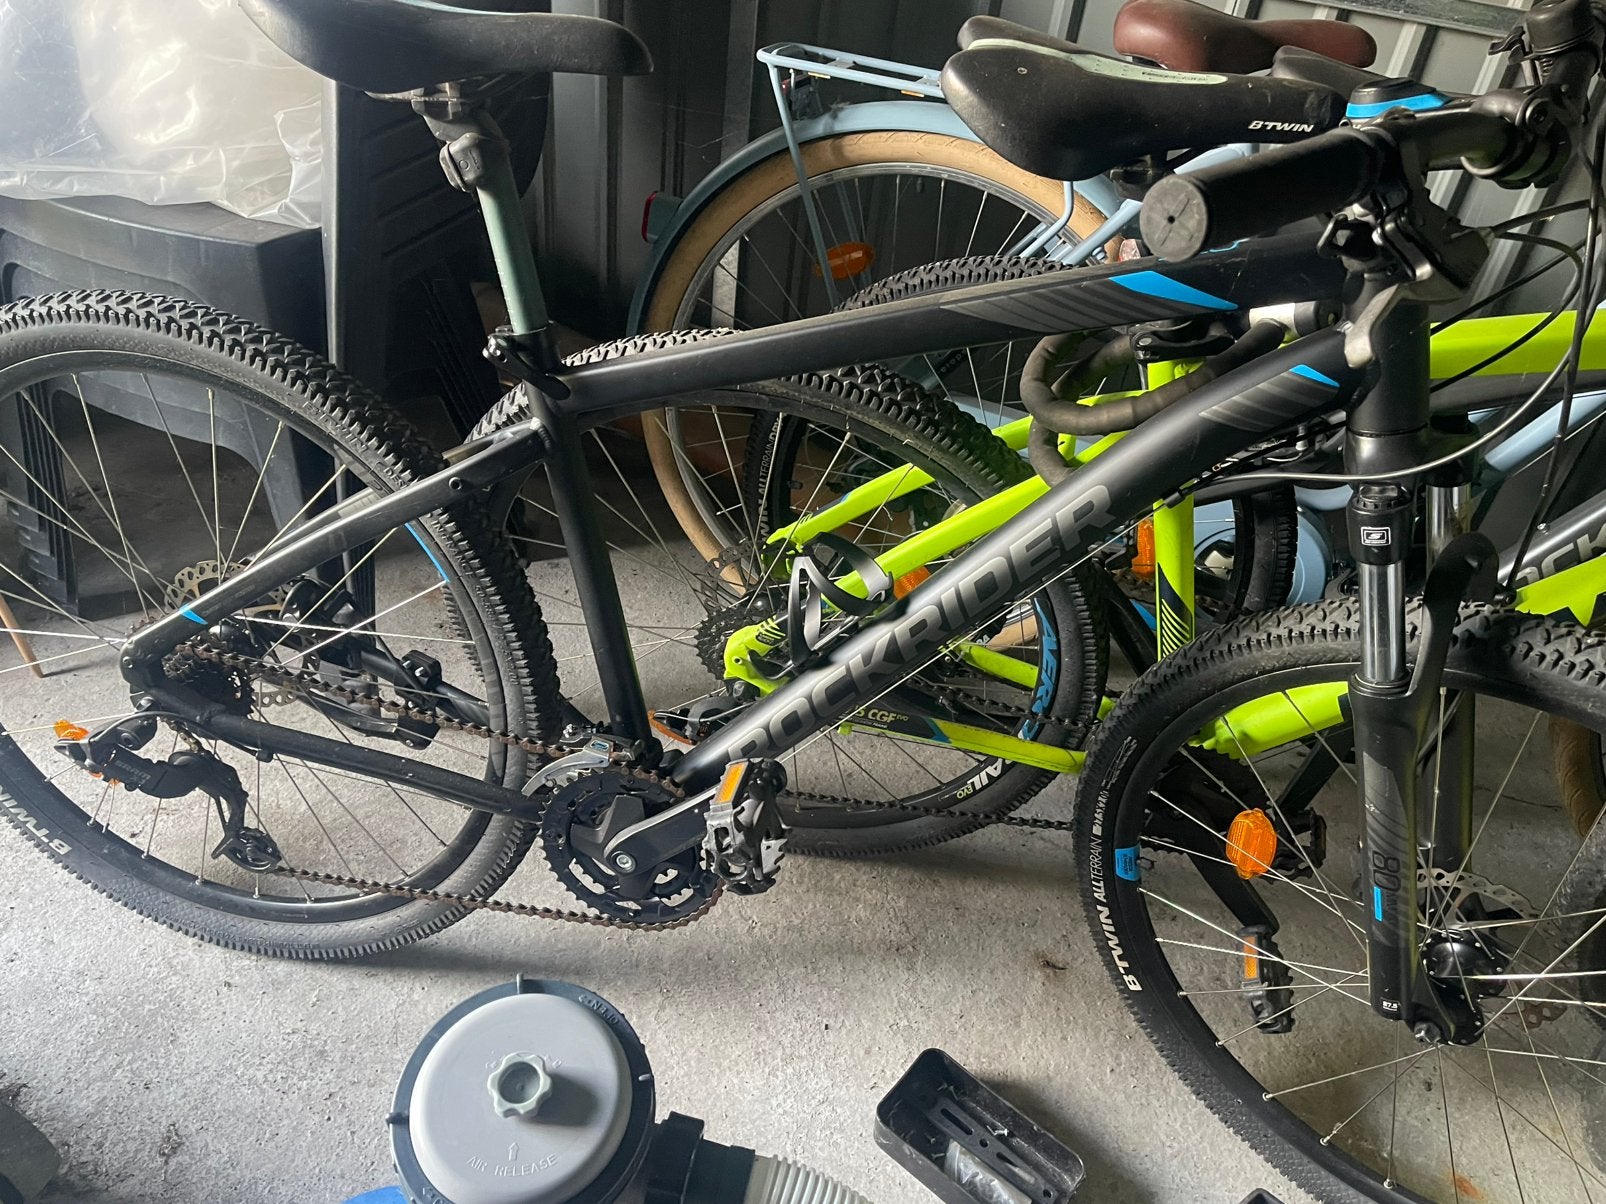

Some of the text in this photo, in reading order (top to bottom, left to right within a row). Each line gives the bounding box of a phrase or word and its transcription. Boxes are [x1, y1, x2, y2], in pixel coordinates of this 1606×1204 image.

[727, 485, 1117, 760] ROCKRIDER
[966, 758, 1015, 791] AIL
[466, 1153, 558, 1177] AIR RELEASE
